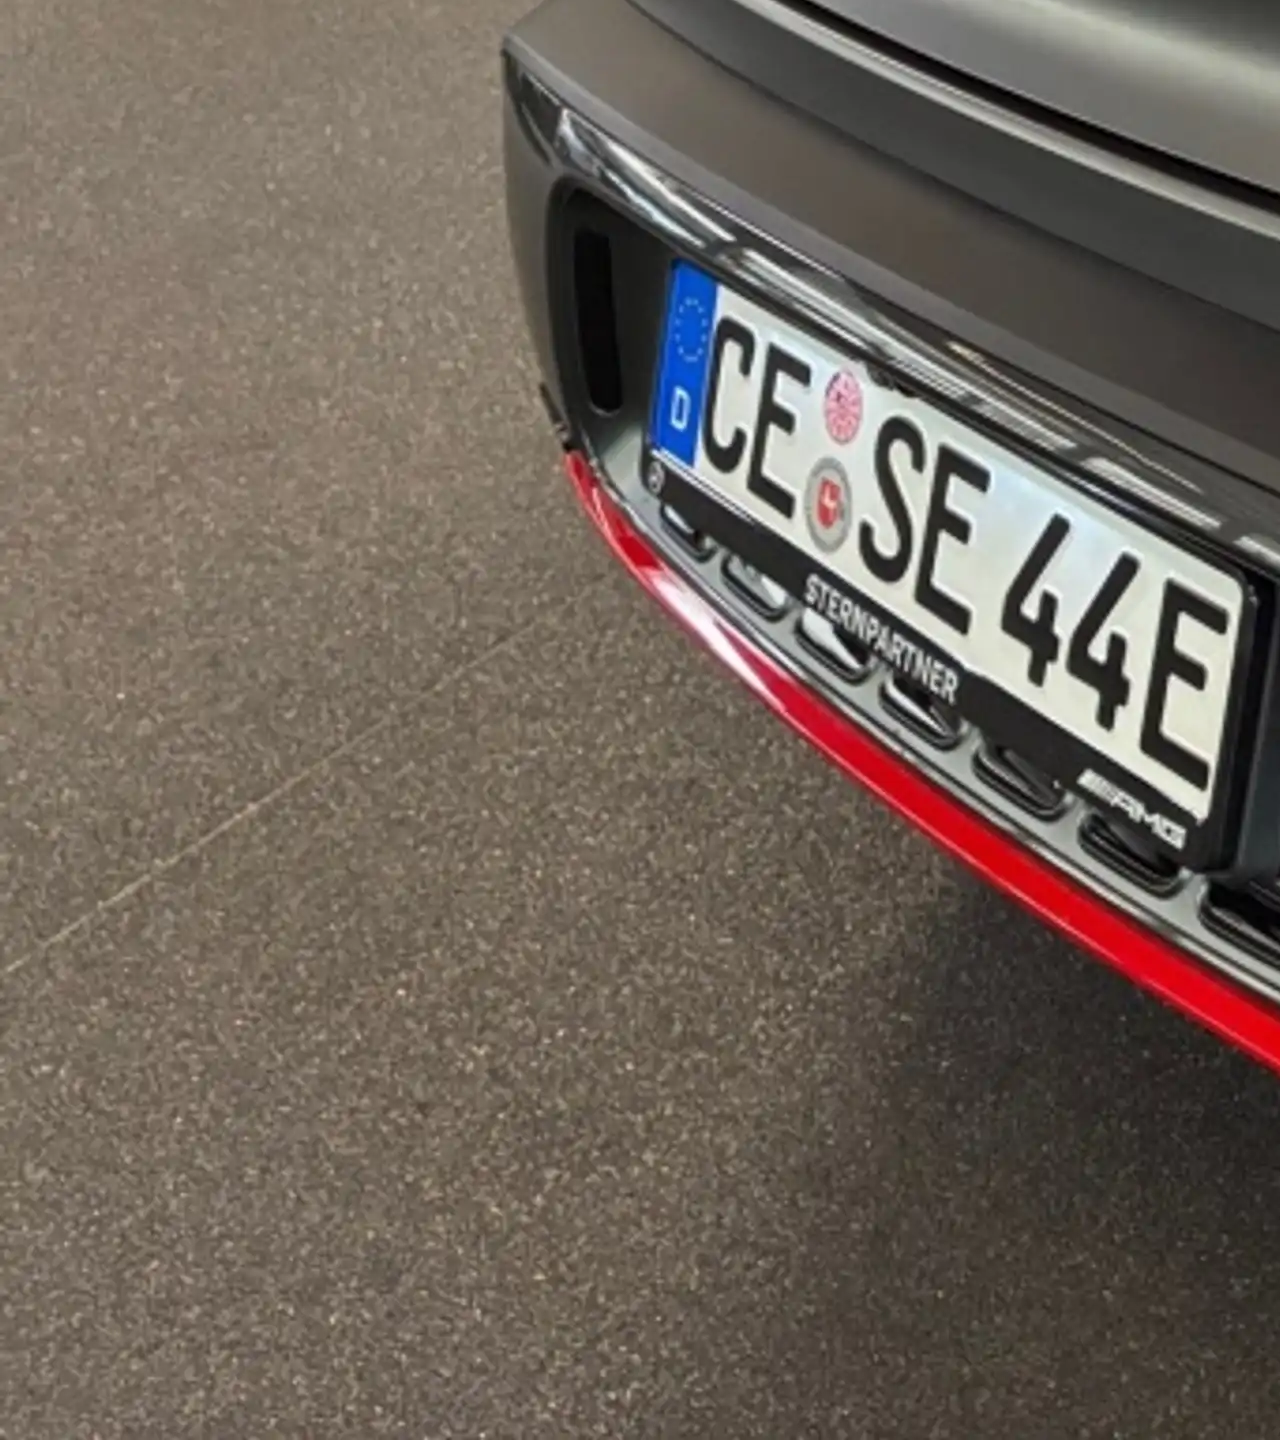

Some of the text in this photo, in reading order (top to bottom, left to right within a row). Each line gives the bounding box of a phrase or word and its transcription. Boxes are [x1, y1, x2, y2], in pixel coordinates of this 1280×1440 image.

[670, 386, 691, 432] D
[702, 316, 812, 520] CE
[857, 416, 991, 636] SE
[1000, 512, 1229, 791] 44E
[804, 572, 959, 707] STERNPARTNER
